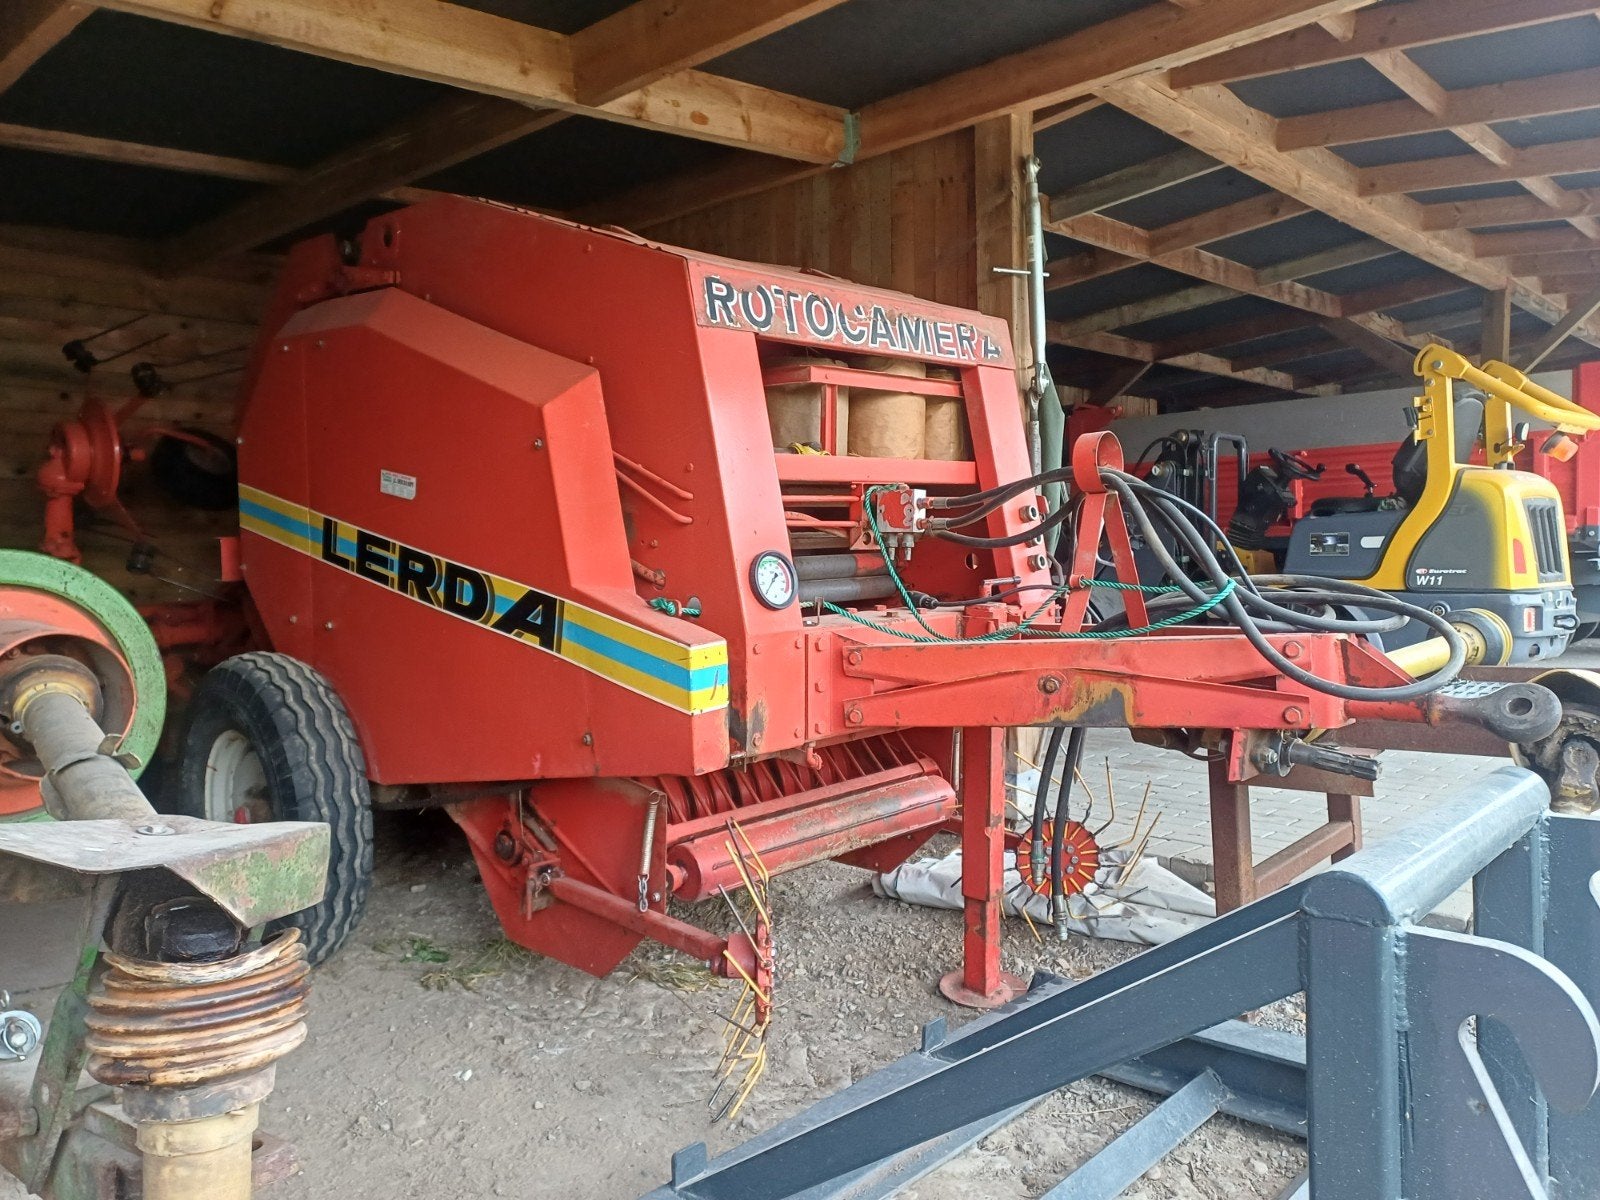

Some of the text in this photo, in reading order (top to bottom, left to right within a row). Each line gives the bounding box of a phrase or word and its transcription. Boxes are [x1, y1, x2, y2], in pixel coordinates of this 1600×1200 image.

[704, 275, 1001, 361] ROTOCAMERA
[322, 517, 565, 654] LERDA
[1416, 575, 1443, 586] W11
